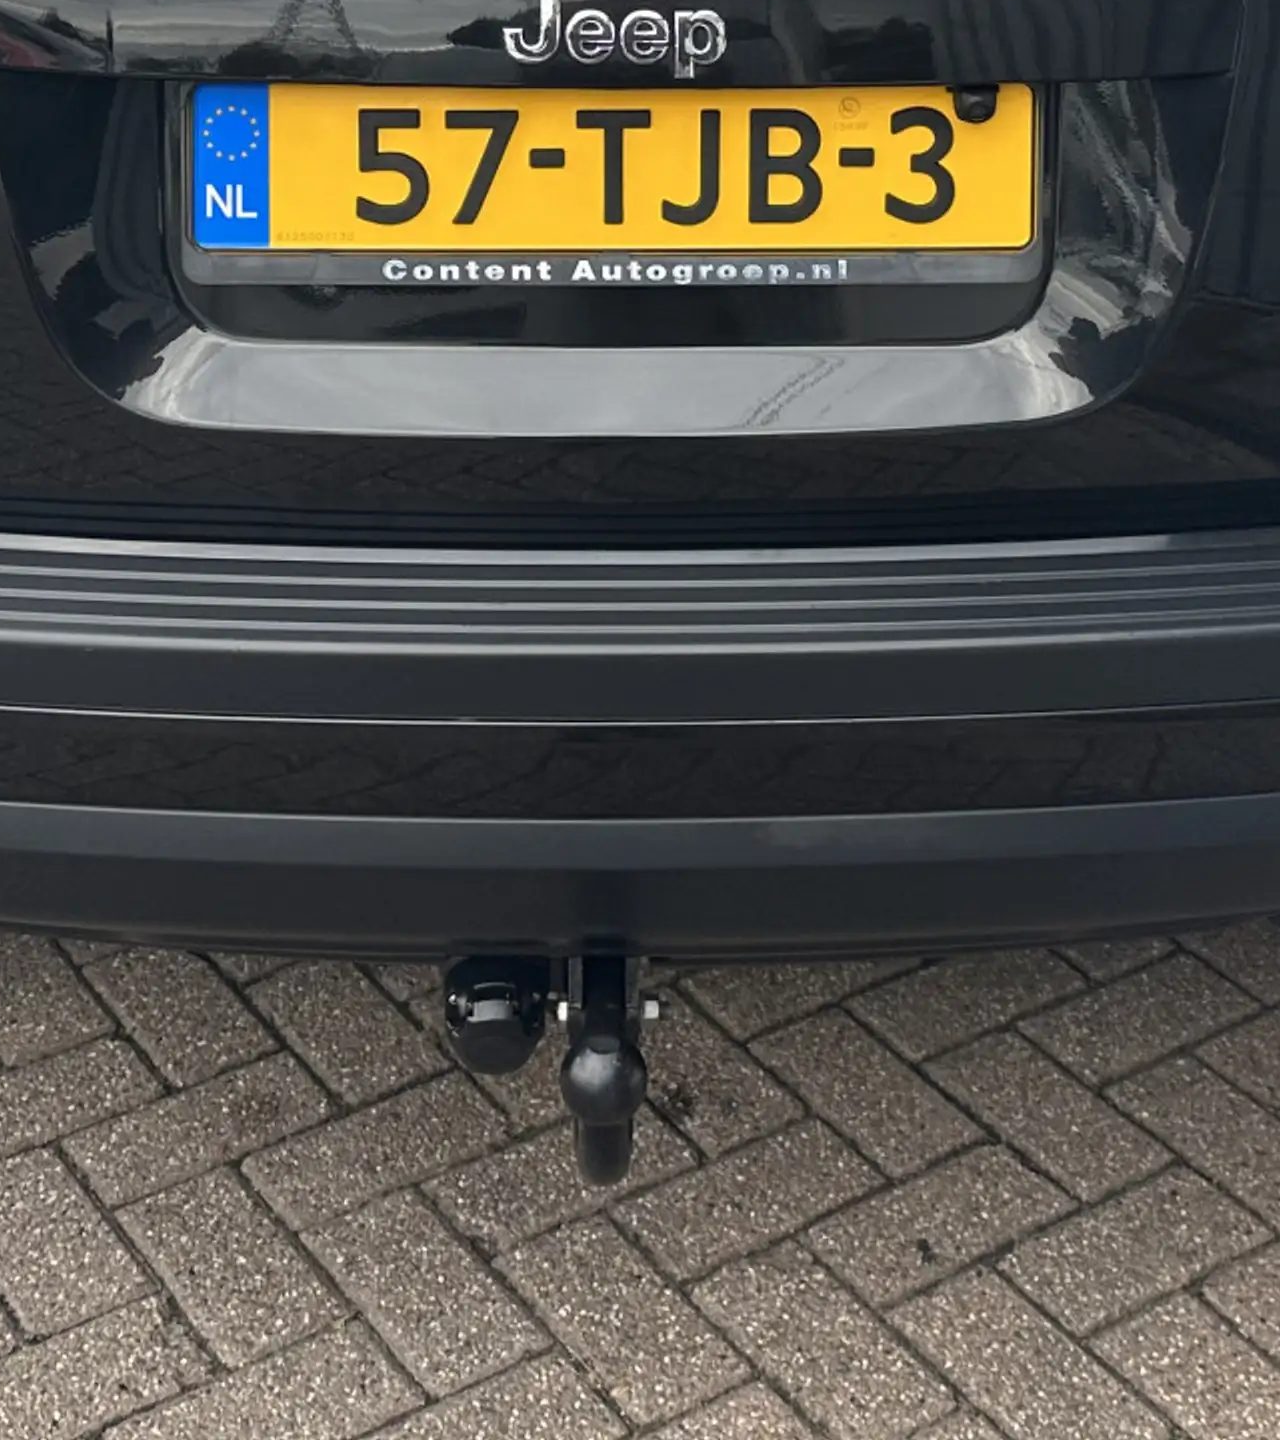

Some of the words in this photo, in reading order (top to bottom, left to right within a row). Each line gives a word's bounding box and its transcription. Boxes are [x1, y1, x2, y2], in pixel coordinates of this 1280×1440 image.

[204, 184, 259, 220] NL
[354, 106, 958, 227] 57-TJB-3
[382, 259, 553, 282] Content
[570, 259, 849, 286] Autogroep.nl
